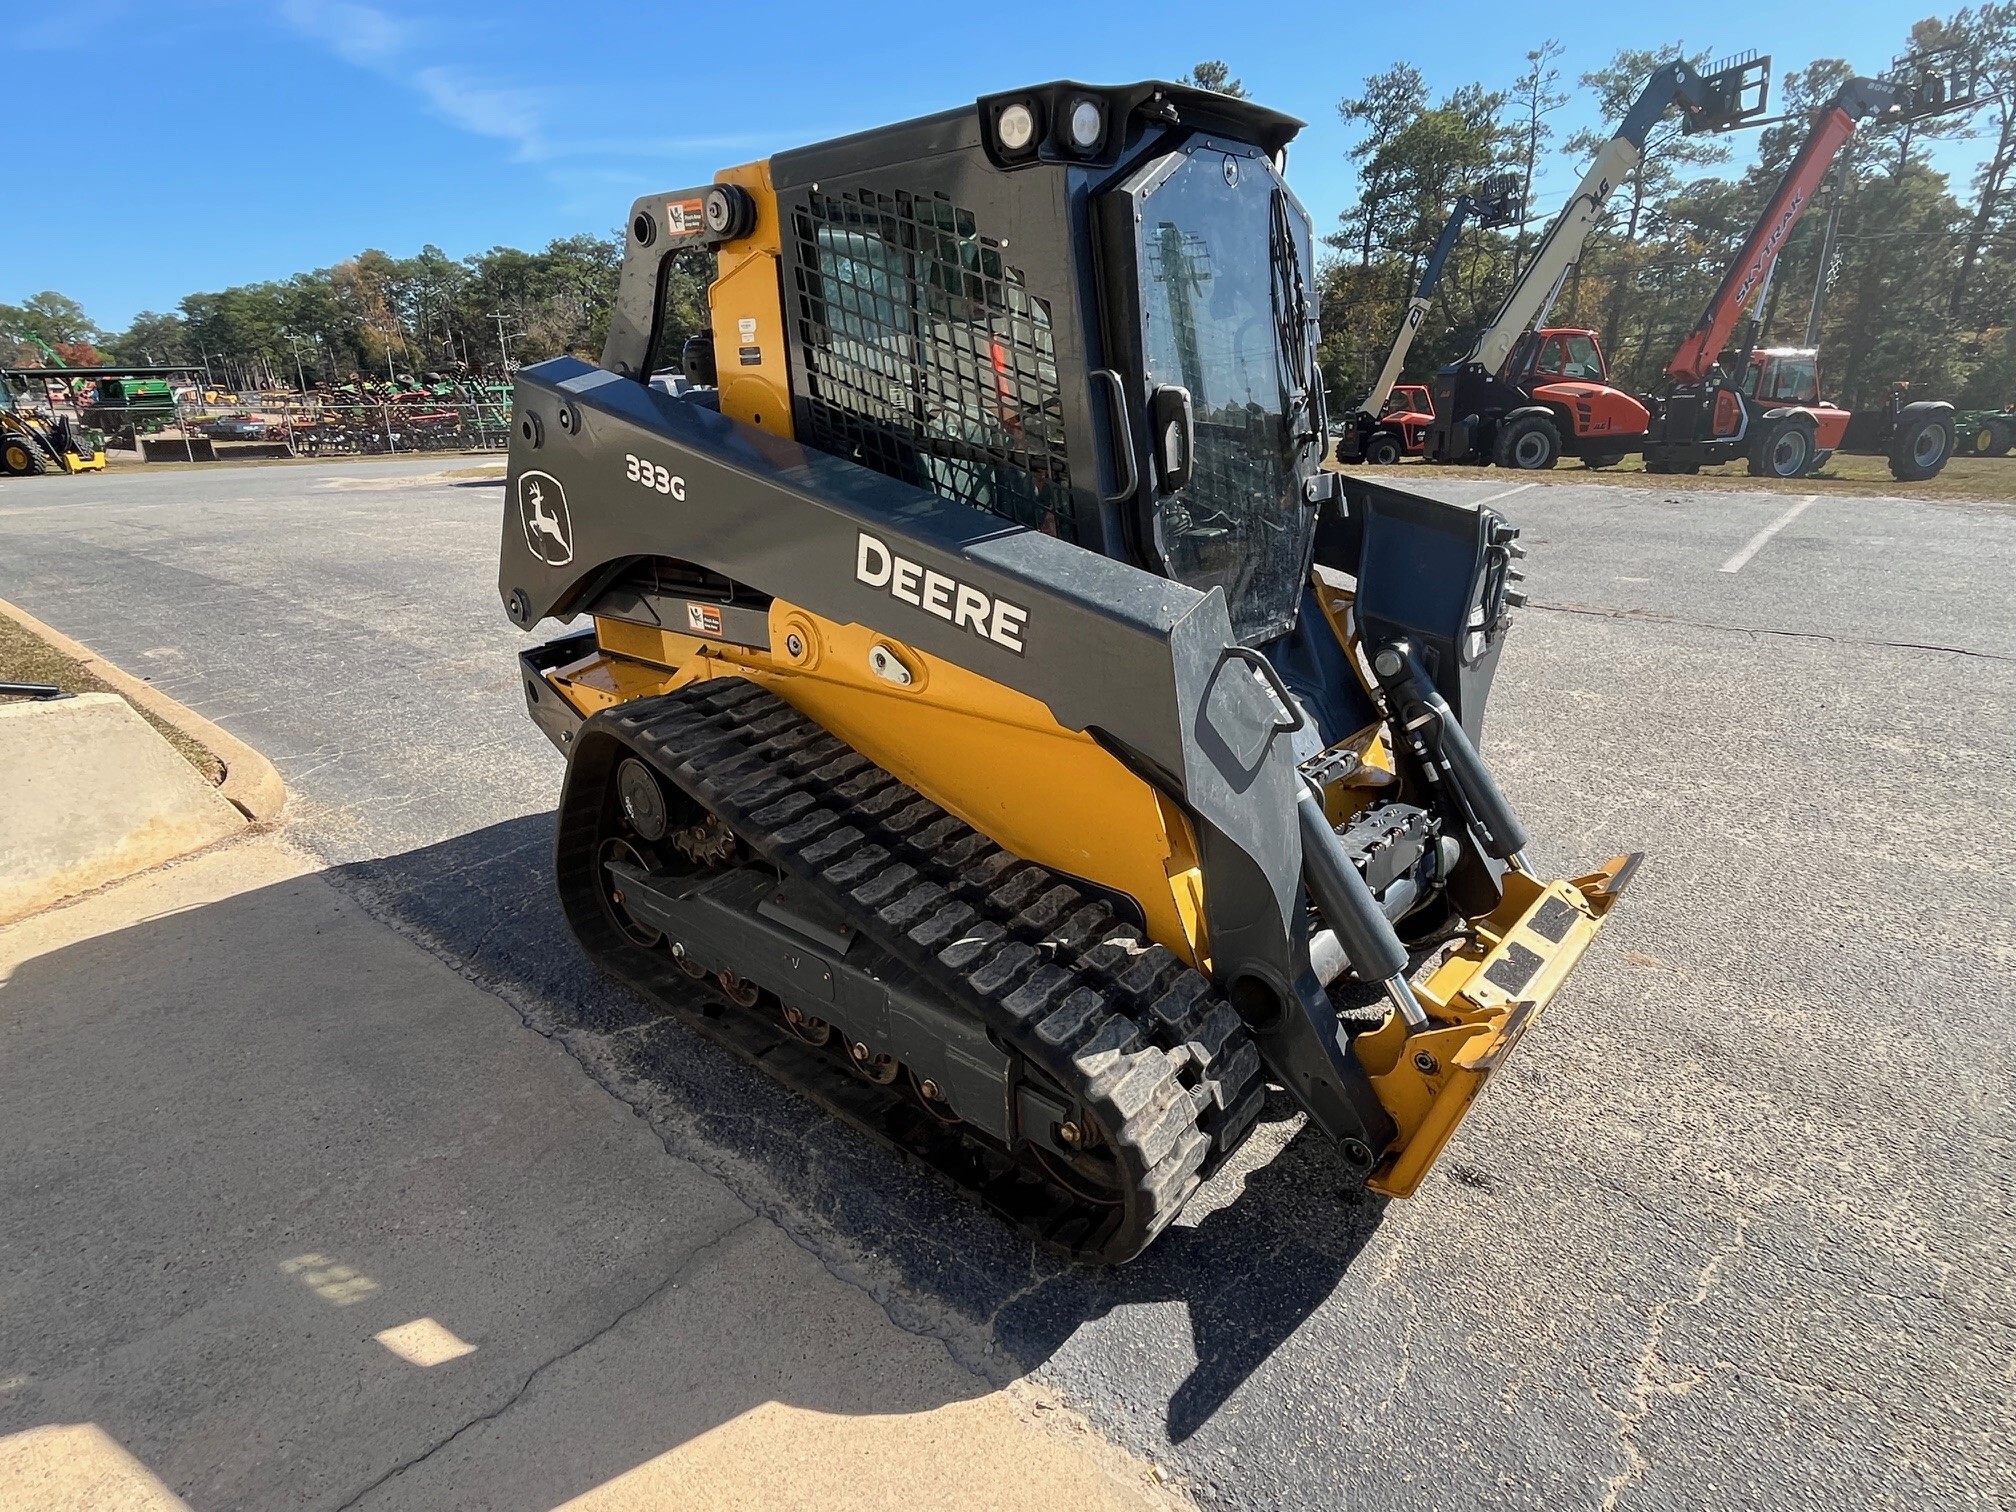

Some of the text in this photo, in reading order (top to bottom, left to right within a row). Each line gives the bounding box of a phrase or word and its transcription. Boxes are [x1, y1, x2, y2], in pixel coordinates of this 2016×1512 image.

[1735, 188, 1804, 307] SKYTRAK
[625, 453, 686, 502] 333G
[856, 532, 1027, 653] DEERE
